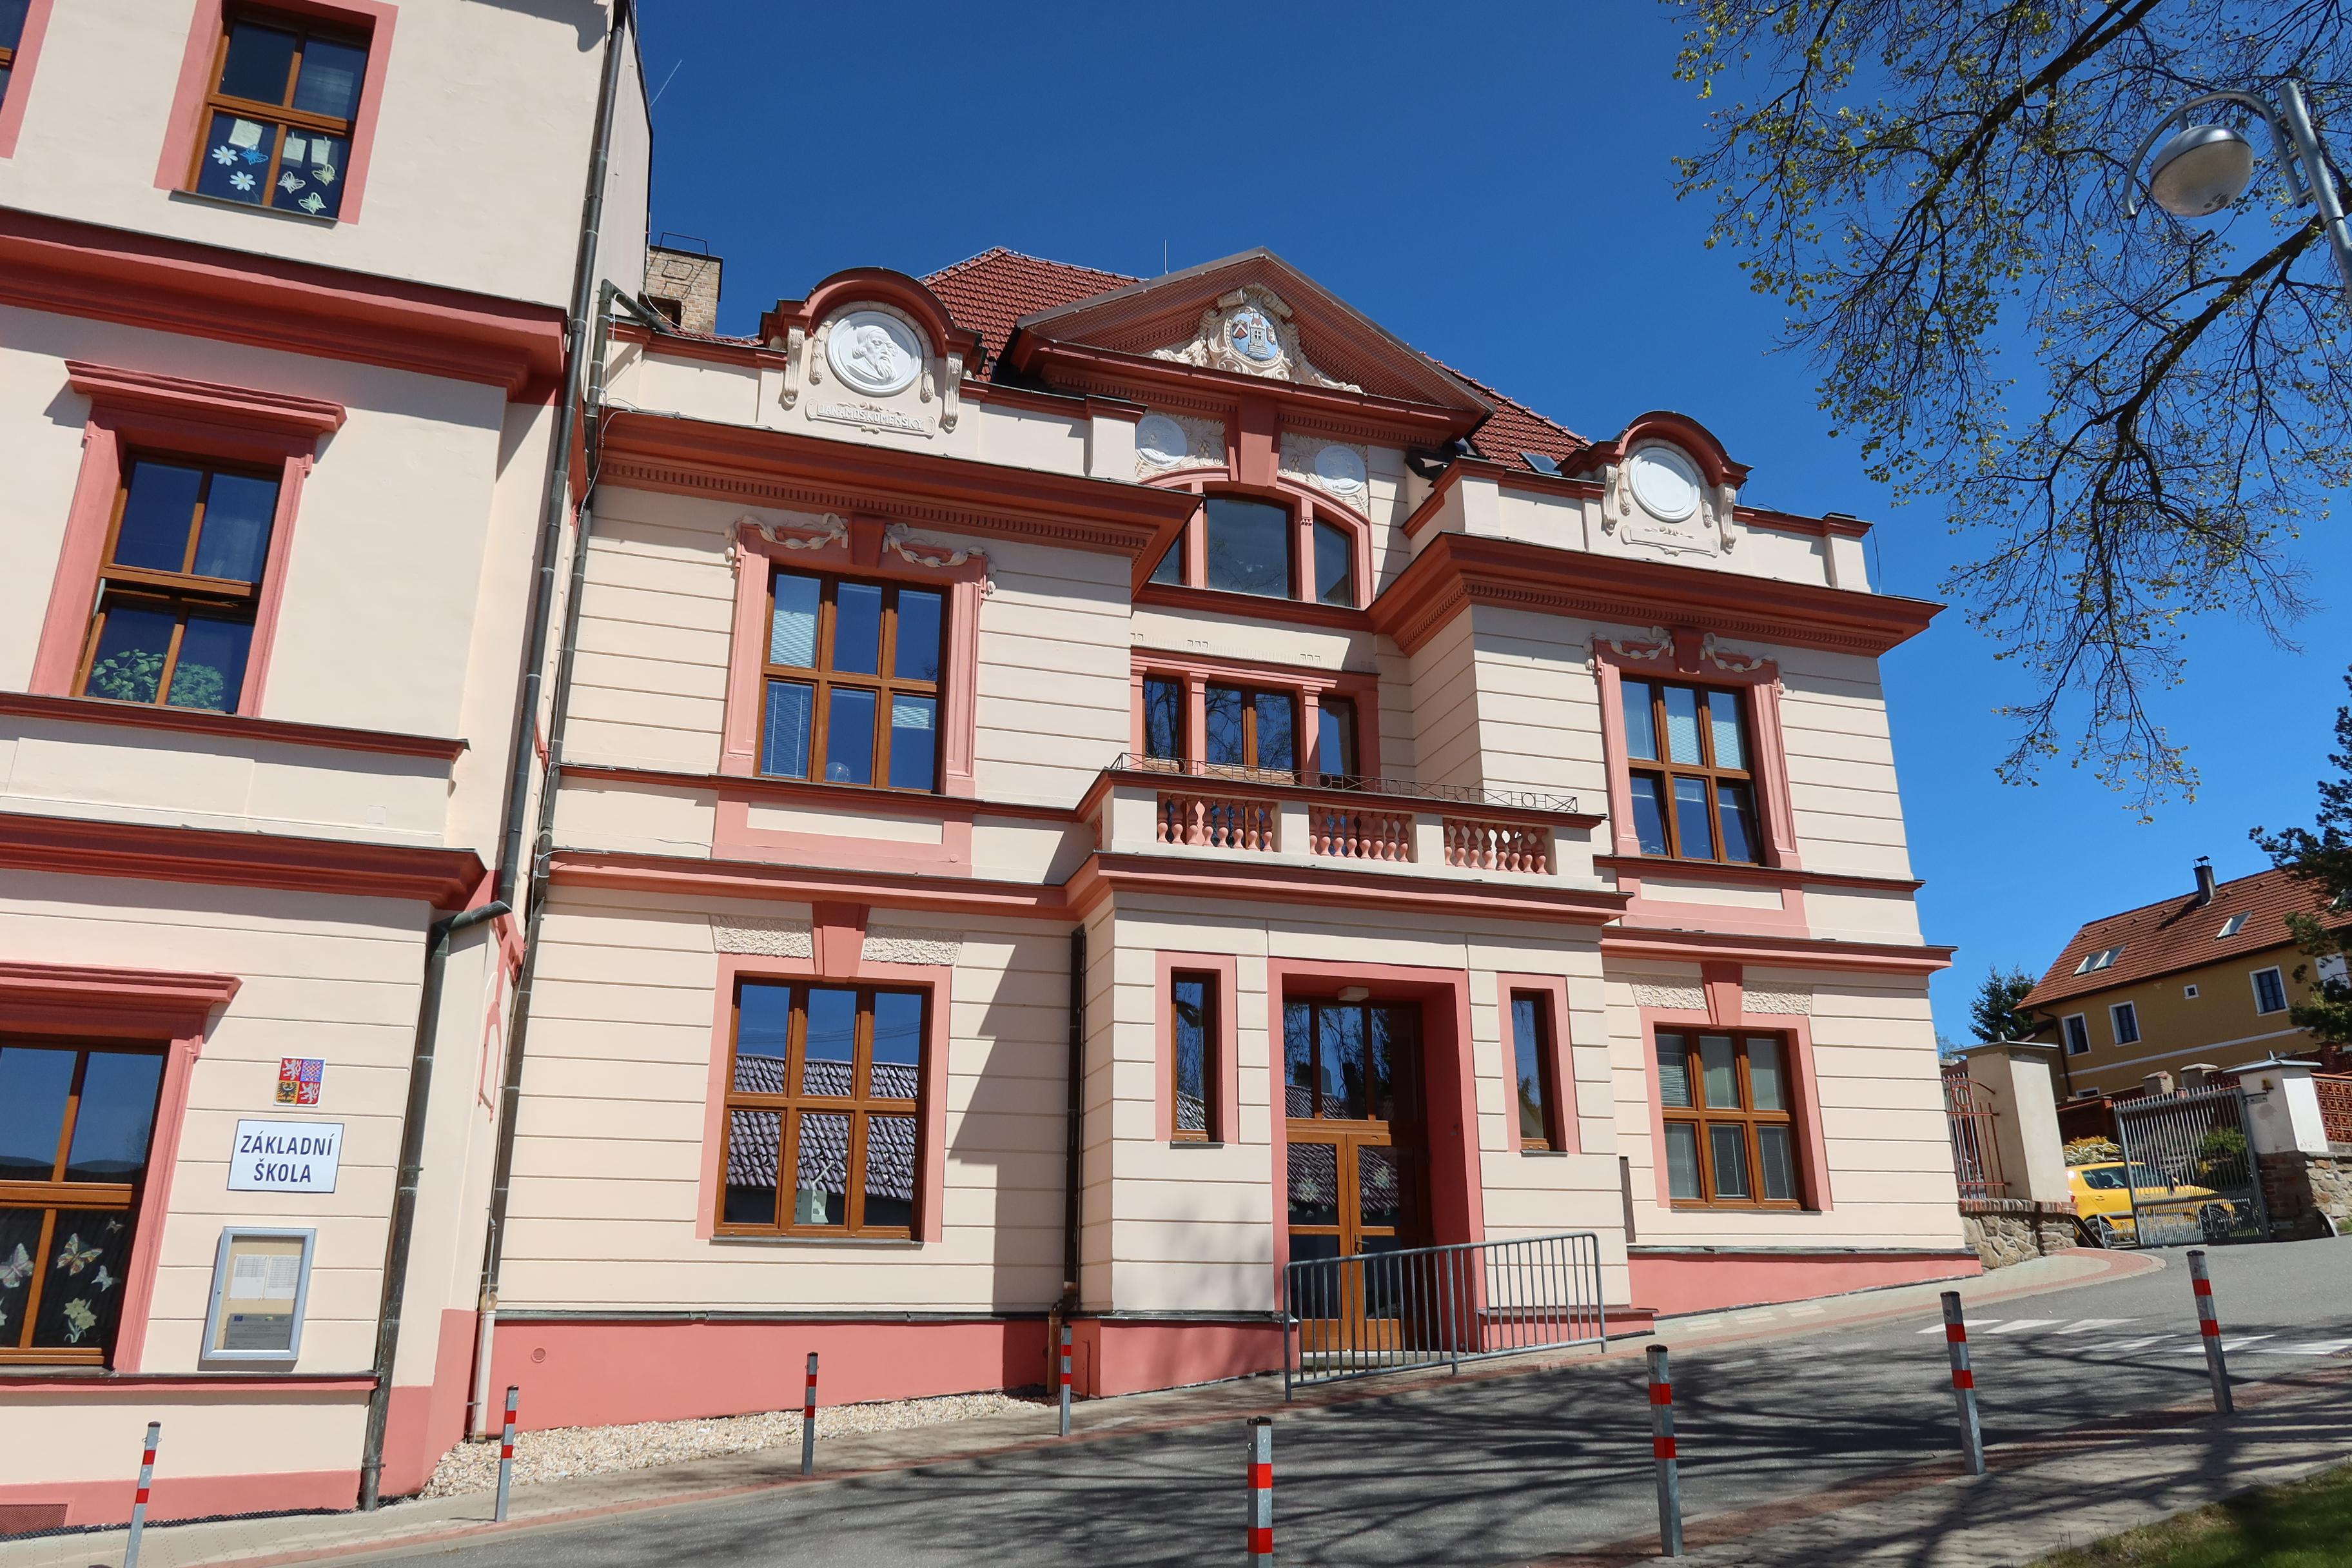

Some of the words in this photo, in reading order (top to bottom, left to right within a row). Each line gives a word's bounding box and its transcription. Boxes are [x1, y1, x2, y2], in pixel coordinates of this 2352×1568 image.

[838, 407, 867, 420] AMOS
[240, 1130, 335, 1155] ZÁKLADNÍ
[254, 1158, 311, 1182] ŠKOLA
